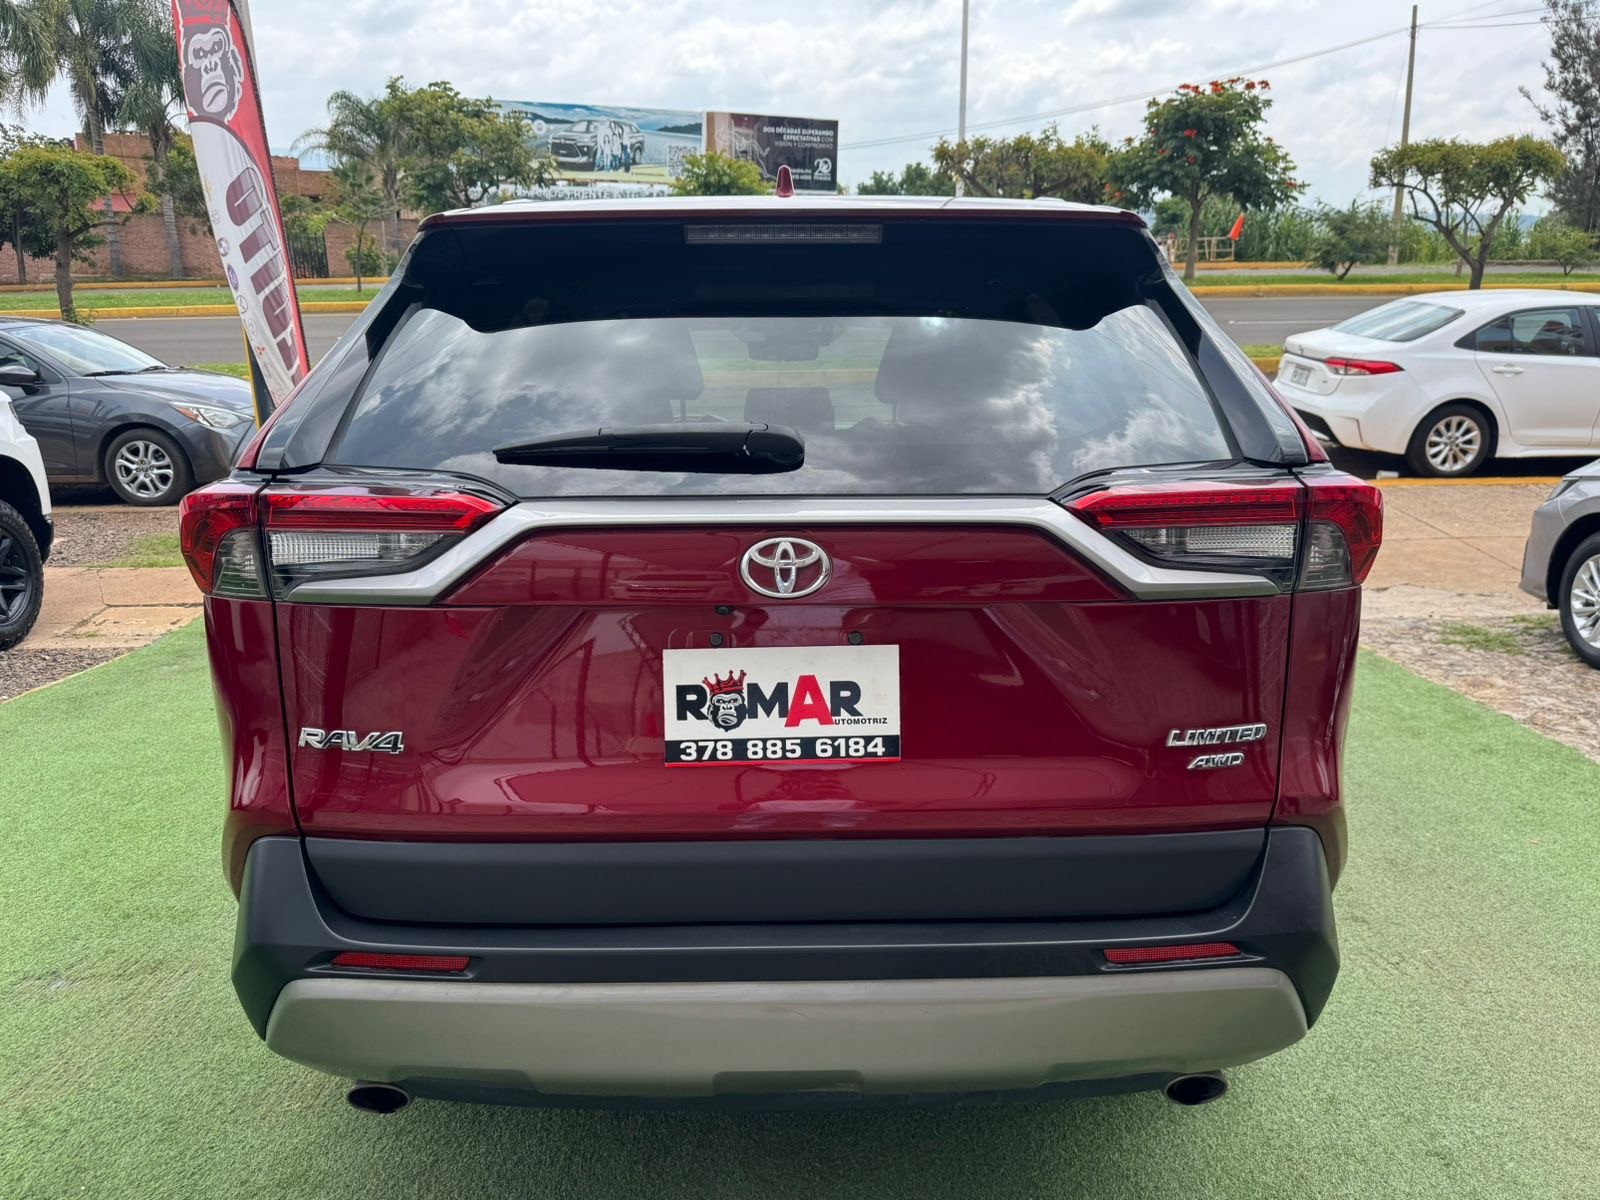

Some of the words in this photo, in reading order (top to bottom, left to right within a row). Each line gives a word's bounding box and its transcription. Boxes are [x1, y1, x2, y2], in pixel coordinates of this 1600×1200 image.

[802, 128, 833, 136] SUPERANDO
[676, 674, 863, 728] RMAR
[298, 727, 405, 754] RAV4
[1166, 723, 1267, 747] LIMITED
[680, 740, 733, 761] 378
[747, 739, 801, 759] 885
[815, 737, 885, 758] 6184
[1187, 752, 1245, 770] AWD
